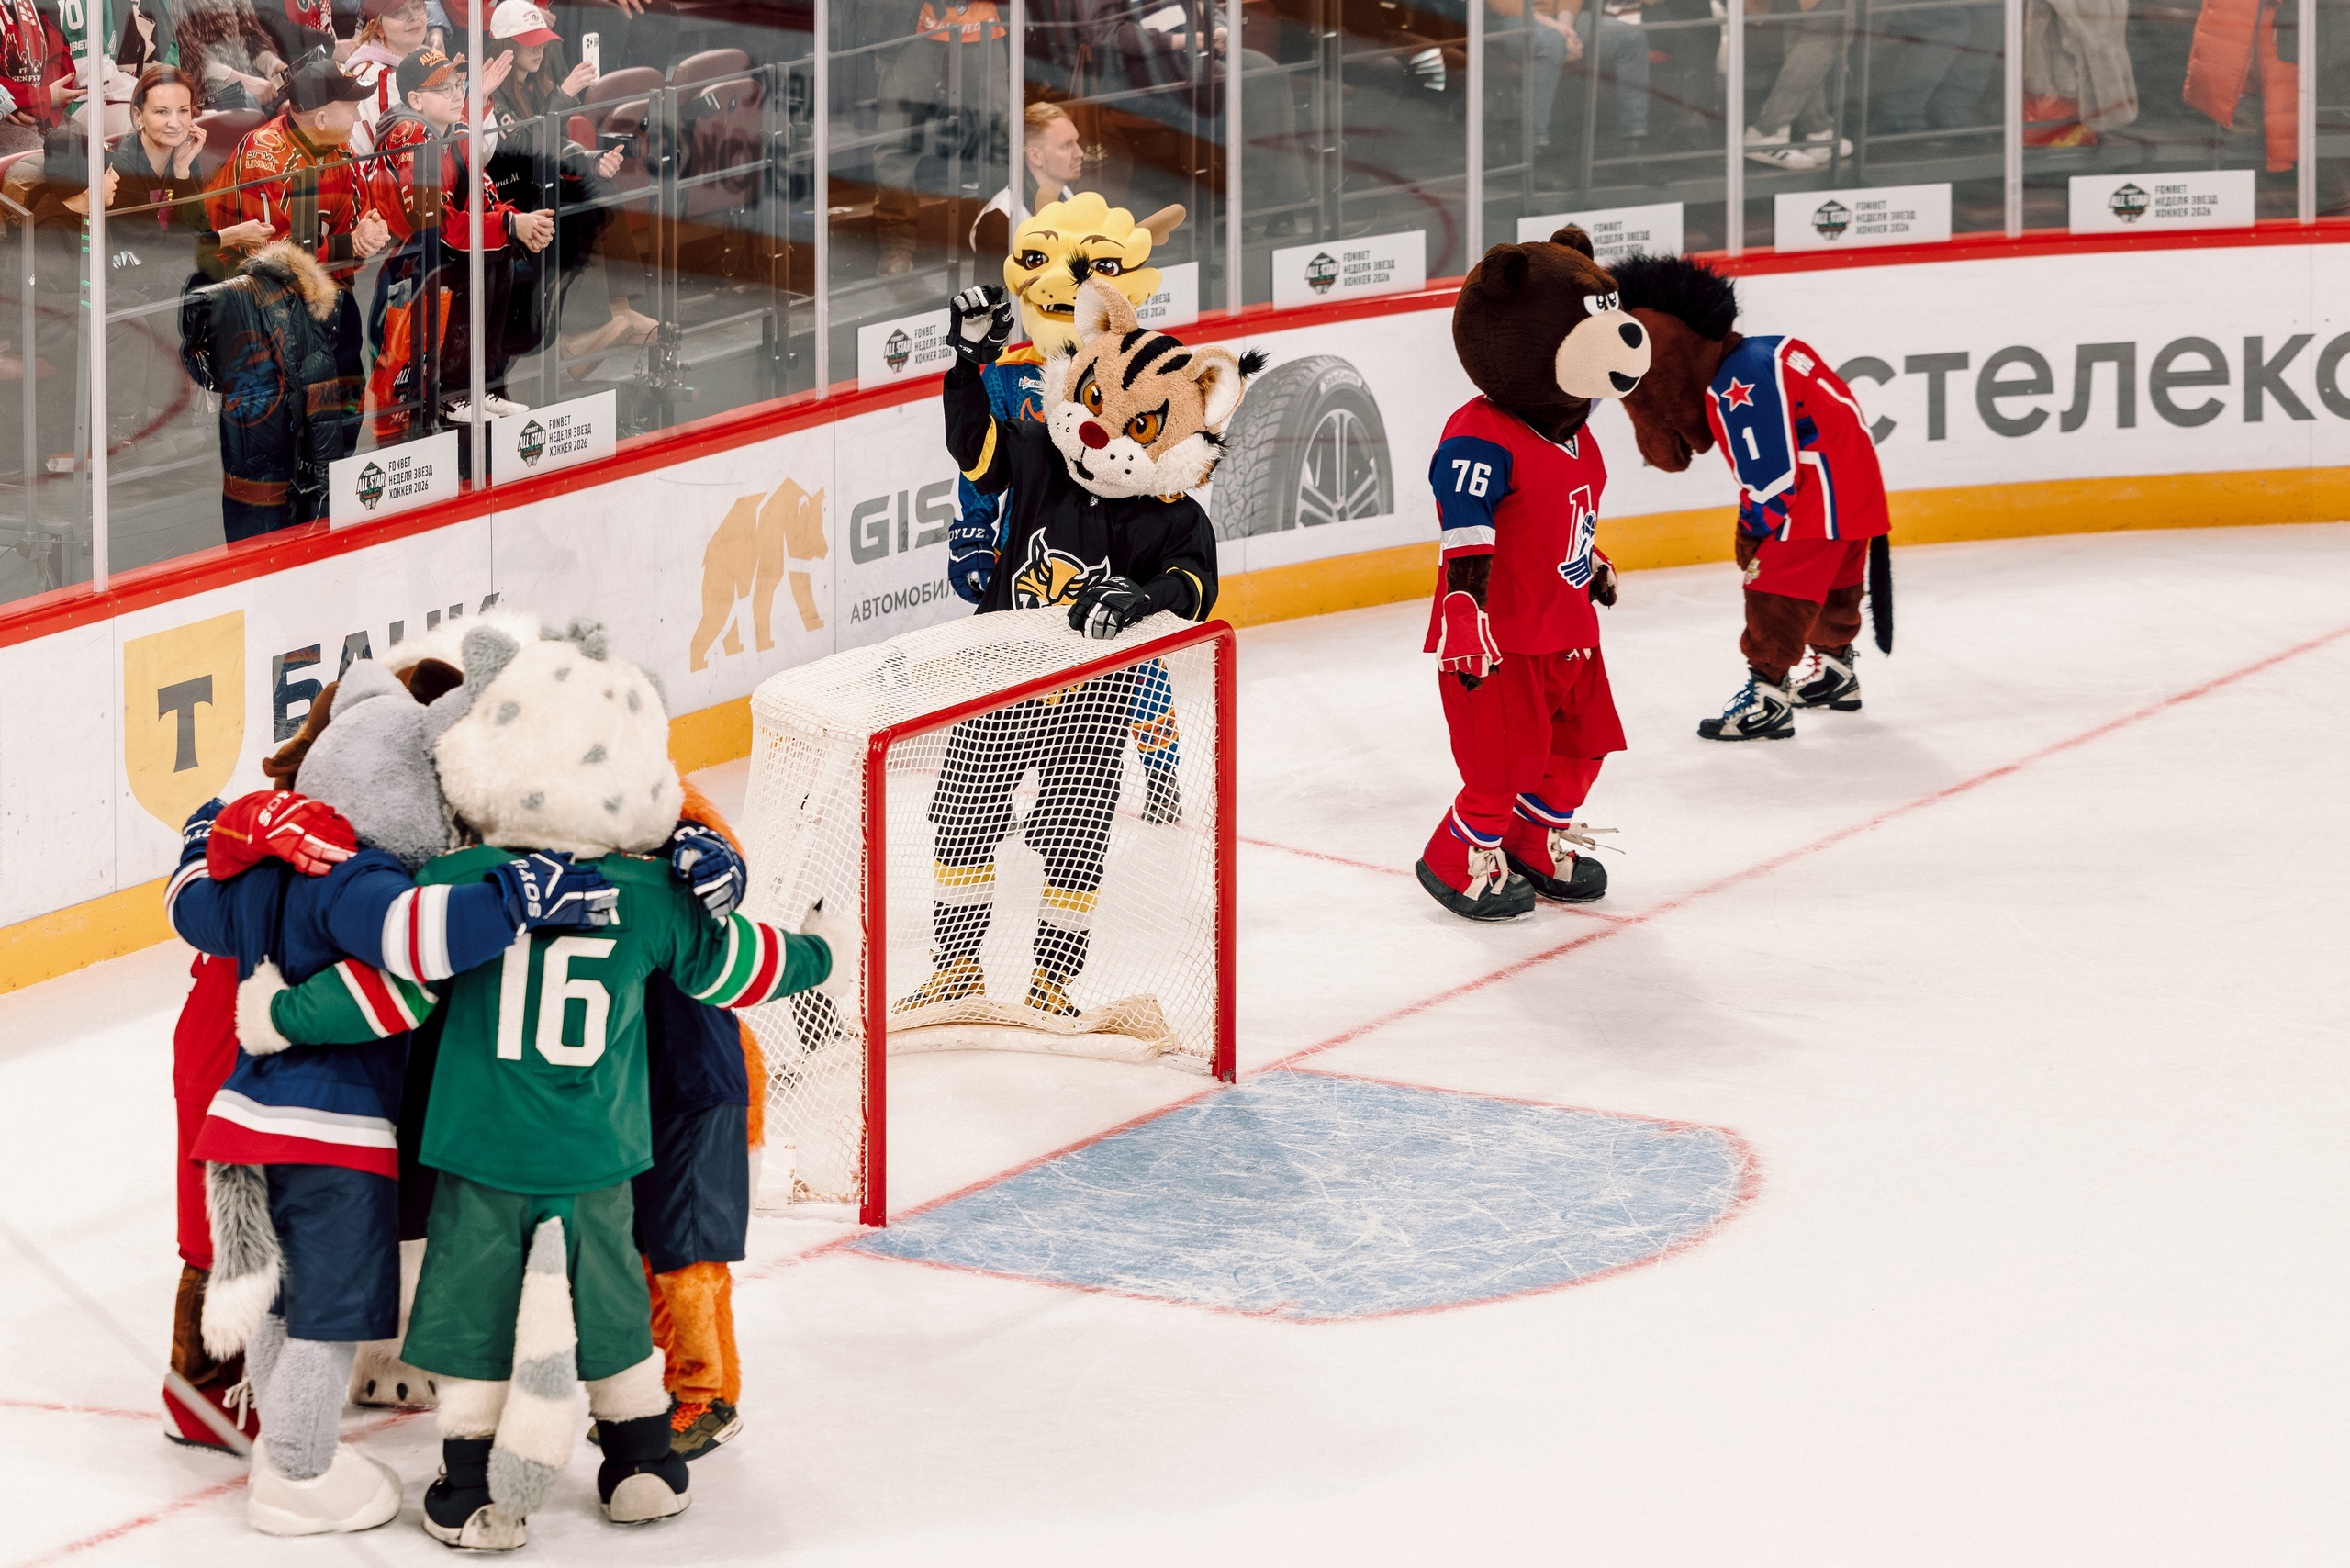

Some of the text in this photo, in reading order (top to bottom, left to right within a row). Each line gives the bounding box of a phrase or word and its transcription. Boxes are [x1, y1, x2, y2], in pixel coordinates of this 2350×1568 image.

[914, 325, 936, 339] FONBET
[914, 338, 937, 352] НЕДЕЛЯ
[914, 350, 937, 364] ХОККЕЯ
[938, 347, 952, 360] 2026
[549, 415, 571, 430] FONBET
[549, 422, 592, 443] НЕДЕЛЯ ЗВЕЗД
[549, 442, 572, 457] ХОККЕЯ
[574, 438, 588, 451] 2026
[1742, 426, 1760, 461] 1
[388, 456, 412, 472] FONBET
[388, 465, 433, 486] НЕДЕЛЯ ЗВЕЗД
[1451, 459, 1492, 498] 76
[388, 484, 412, 499] ХОККЕЯ
[414, 480, 429, 493] 2026
[497, 933, 618, 1067] 16
